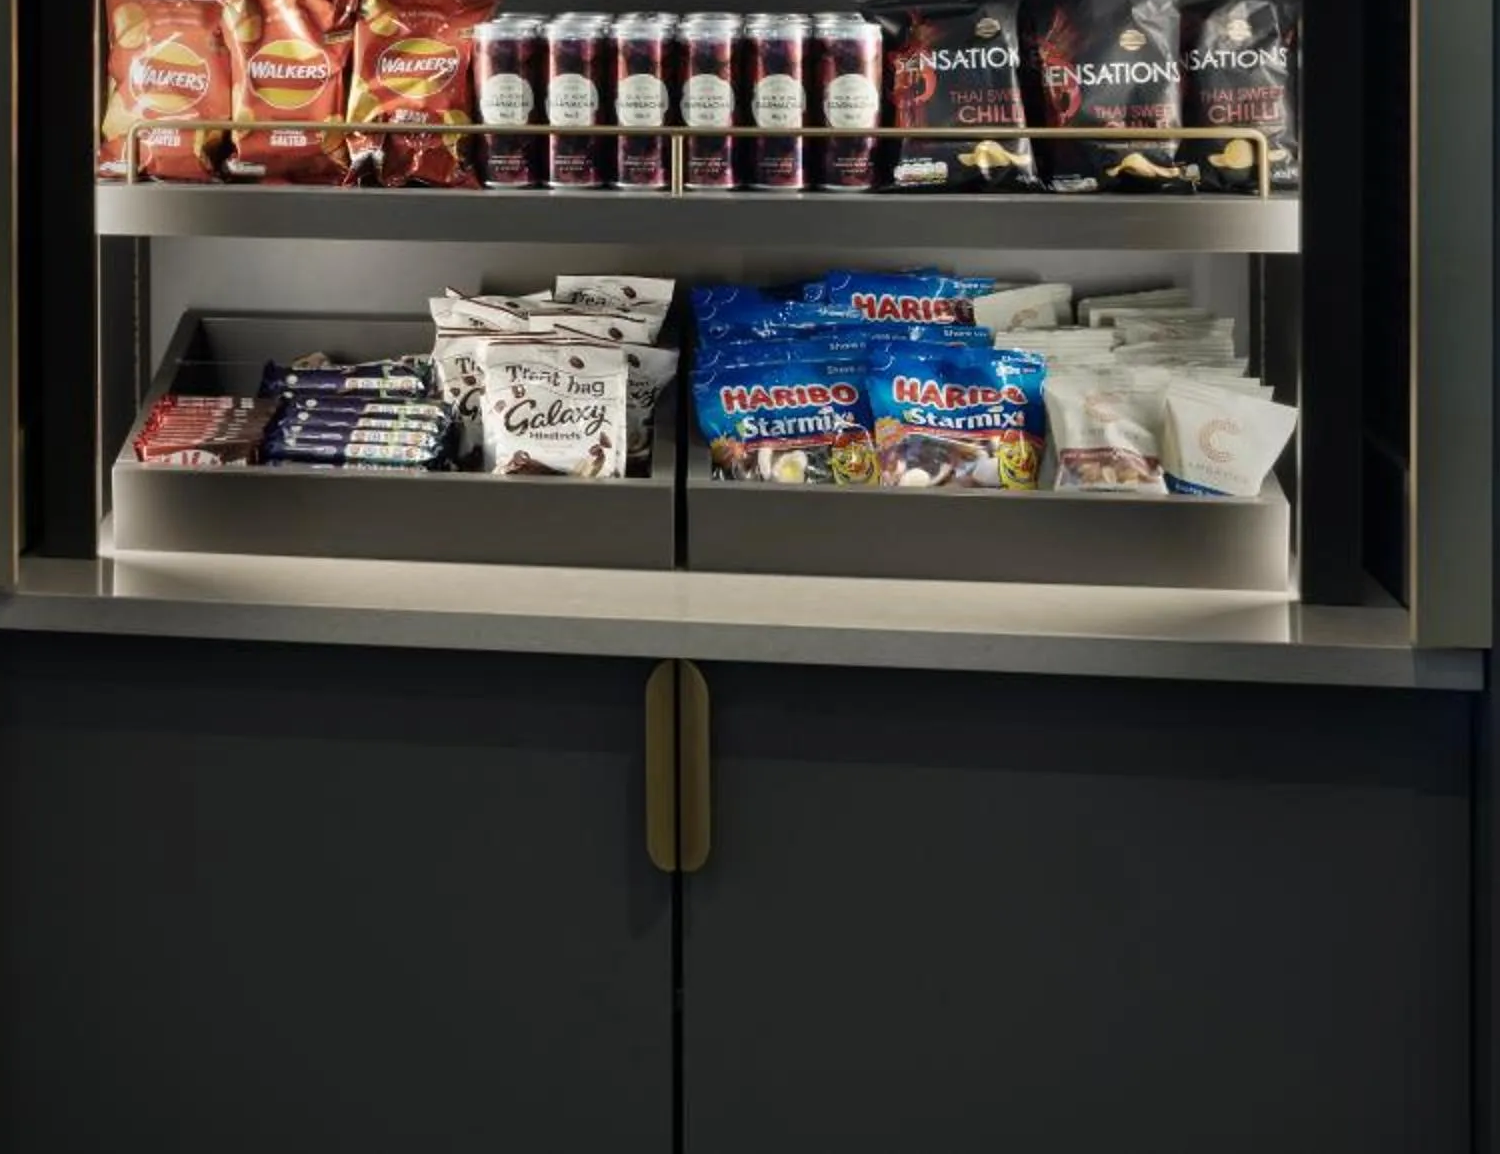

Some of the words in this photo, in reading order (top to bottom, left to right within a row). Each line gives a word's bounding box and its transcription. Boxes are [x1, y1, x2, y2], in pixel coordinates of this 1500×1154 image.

[132, 62, 207, 92] WALKERS
[251, 60, 327, 80] WALKERS
[381, 56, 457, 75] WALKERS
[505, 365, 560, 388] Treat
[568, 372, 605, 397] bag
[894, 376, 1027, 408] HARIBO
[720, 383, 858, 414] HARIBO
[503, 400, 612, 437] Galaxy
[741, 409, 846, 439] Starmix
[909, 409, 1014, 429] Starmix
